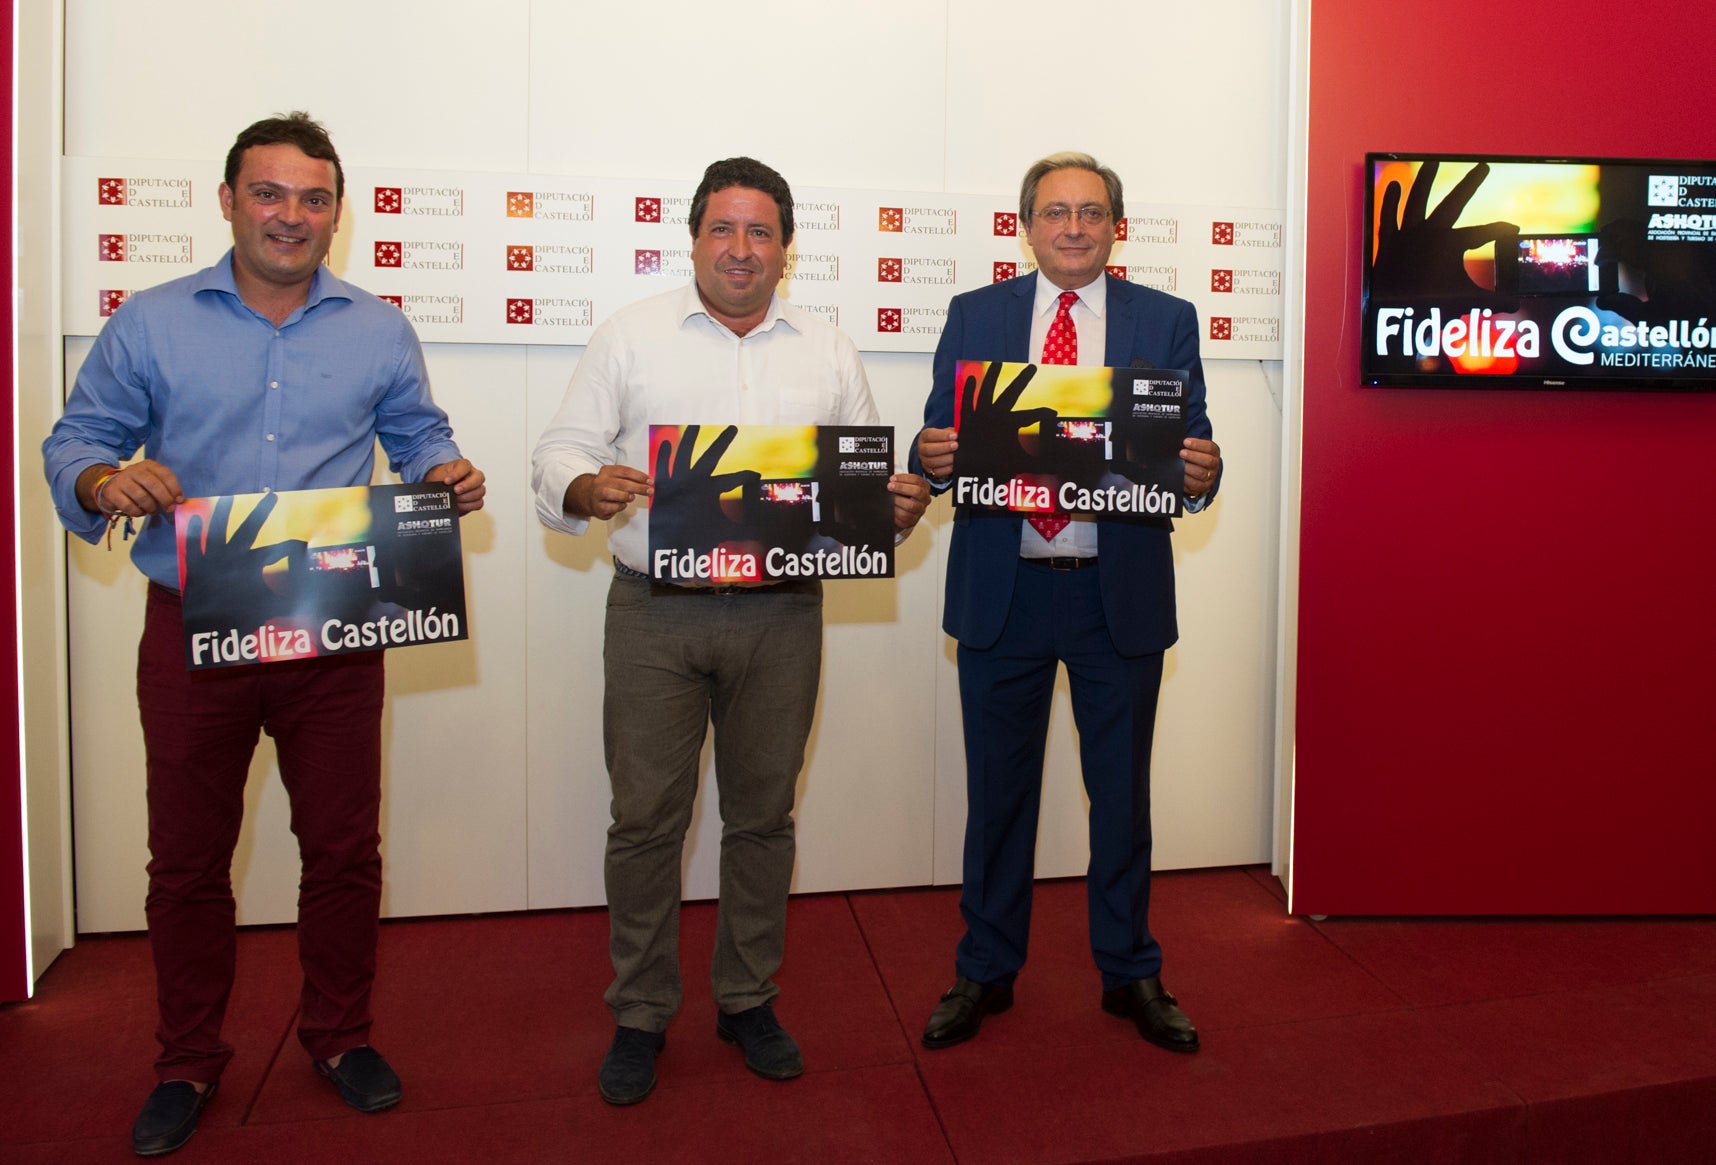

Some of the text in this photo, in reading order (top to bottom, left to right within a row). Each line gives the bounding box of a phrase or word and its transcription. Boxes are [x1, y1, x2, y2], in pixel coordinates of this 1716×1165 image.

[129, 178, 188, 188] DIPUTACIÓ
[403, 187, 460, 197] DIPUTACIÓ
[1679, 186, 1687, 196] D
[535, 192, 590, 202] DIPUTACIÓ
[662, 197, 693, 206] DIPUT
[128, 198, 189, 208] CASTELLÓ
[1678, 197, 1716, 208] CASTE
[403, 207, 460, 216] CASTELLÓ
[794, 203, 837, 212] PUTACIÓ
[535, 212, 590, 221] CASTELLÓ
[904, 208, 954, 217] DIPUTACIÓ
[662, 217, 689, 225] CAST
[1129, 217, 1174, 226] DIPUTACIÓ
[794, 222, 836, 231] ASTELLÓ
[904, 226, 953, 235] CASTELLÓ
[1235, 222, 1279, 231] DIPUTACIÓ
[129, 234, 189, 243] DIPUTACIÓ
[1129, 235, 1174, 244] CASTELLÓ
[403, 241, 460, 251] DIPUTACIÓ
[1235, 240, 1279, 248] CASTELLÓ
[535, 245, 590, 255] DIPUTACIÓ
[662, 250, 691, 258] DIPUT
[129, 255, 189, 264] CASTELLÓ
[785, 254, 836, 263] DIPUTACIÓ
[903, 258, 952, 266] DIPUTACIÓ
[403, 261, 460, 270] CASTELLÓ
[535, 264, 590, 274] CASTELLÓ
[1128, 266, 1174, 274] DIPUTACIÓ
[785, 272, 836, 281] CASTELLÓ
[1234, 269, 1278, 278] DIPUTACIÓ
[903, 276, 952, 285] CASTELLÓ
[1233, 287, 1278, 295] CASTELLÓ
[403, 295, 460, 305] DIPUTACIÓ
[534, 298, 590, 308] DIPUTACIÓ
[408, 315, 460, 324] ASTELLÓ
[534, 318, 589, 327] CASTELLÓ
[1233, 317, 1276, 325] DIPUTACIÓ
[903, 326, 942, 334] CASTEL
[1376, 307, 1540, 358] Fideliza
[1232, 334, 1276, 342] CASTELLÓ
[957, 477, 1176, 514] Fideliza Castellón
[654, 544, 887, 578] Fideliza Castellón
[192, 607, 459, 665] Fideliza Castellón
